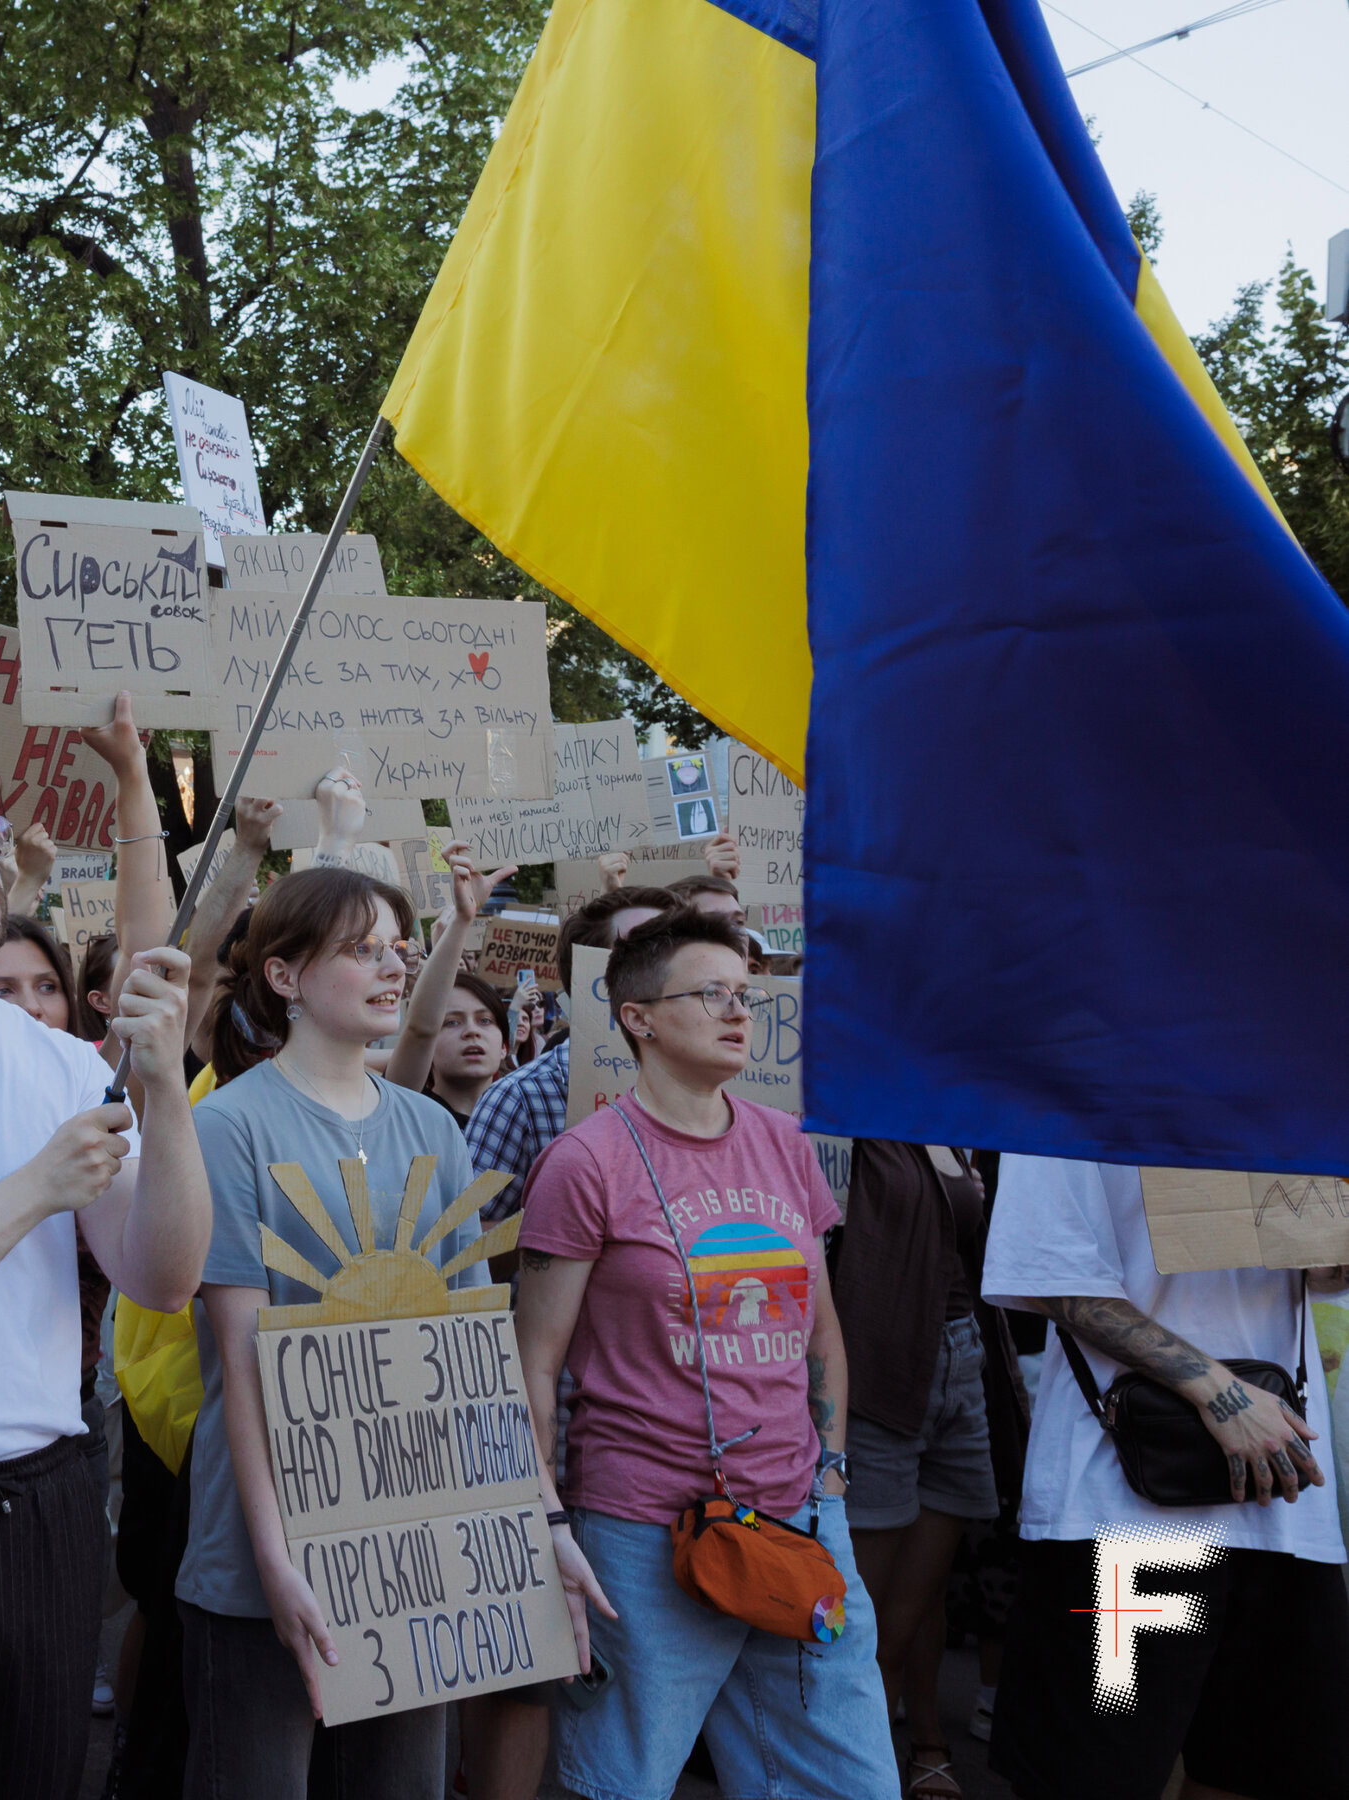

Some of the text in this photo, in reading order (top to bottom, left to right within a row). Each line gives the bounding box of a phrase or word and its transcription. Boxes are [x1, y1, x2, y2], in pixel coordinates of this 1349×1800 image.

[233, 544, 372, 577] ЯКЩО ИР-
[229, 600, 287, 642] МІЙ
[304, 609, 394, 642] ГОЛОС
[45, 616, 182, 673] ГЕТЬ
[338, 661, 372, 684] ЗА
[698, 1188, 723, 1215] IS
[726, 1187, 806, 1235] BETTER
[669, 1333, 744, 1366] WTH
[276, 1327, 400, 1425] СОНЦЕ
